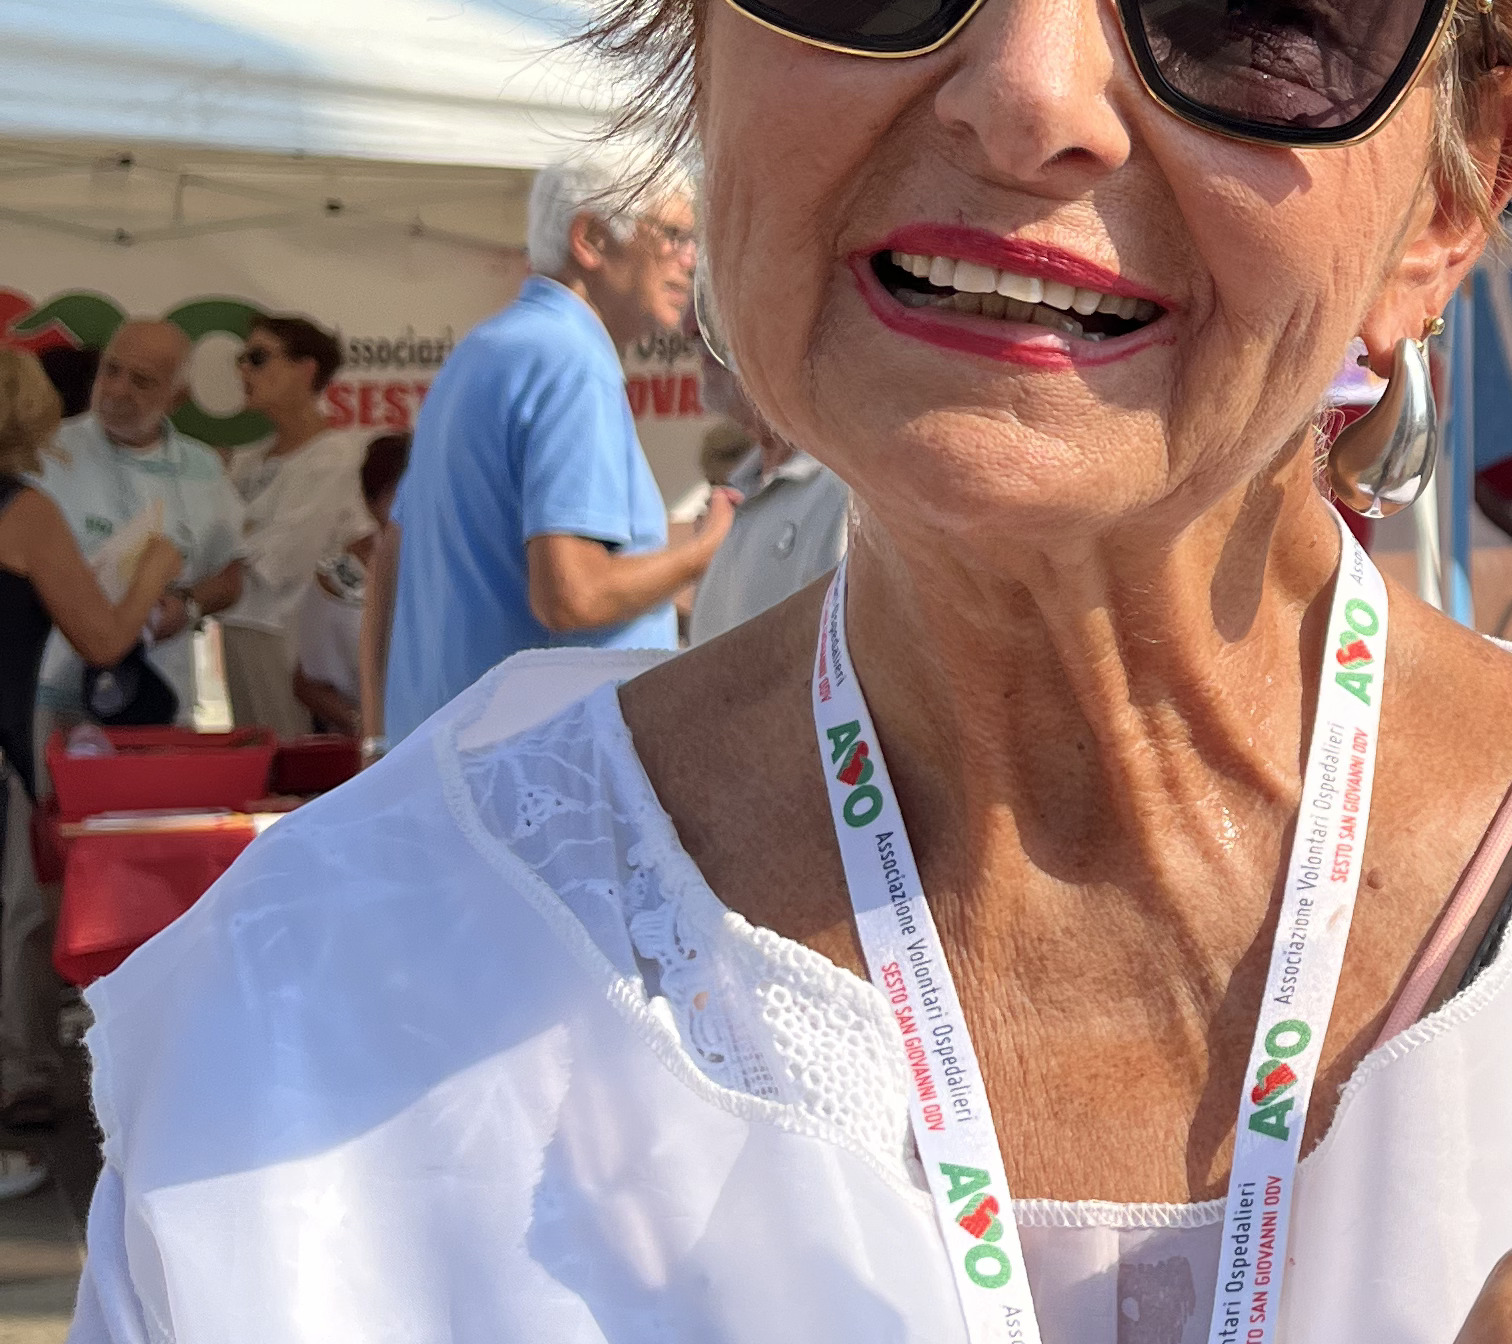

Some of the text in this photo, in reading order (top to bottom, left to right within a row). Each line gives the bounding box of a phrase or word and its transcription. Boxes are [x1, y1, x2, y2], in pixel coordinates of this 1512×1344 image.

[1273, 721, 1344, 1005] Associazione Volontari Ospedalieri
[1330, 728, 1368, 884] SESTO SAN GIOVANNI ODV
[875, 830, 973, 1123] Associazione Volontari Ospedalieri
[881, 961, 945, 1132] SESTO SAN GIOVANNI ODV
[1225, 1181, 1257, 1291] Ospedalieri
[1256, 1207, 1279, 1286] GIOVANNI
[1263, 1174, 1284, 1205] ODV
[1249, 1289, 1269, 1323] SAN
